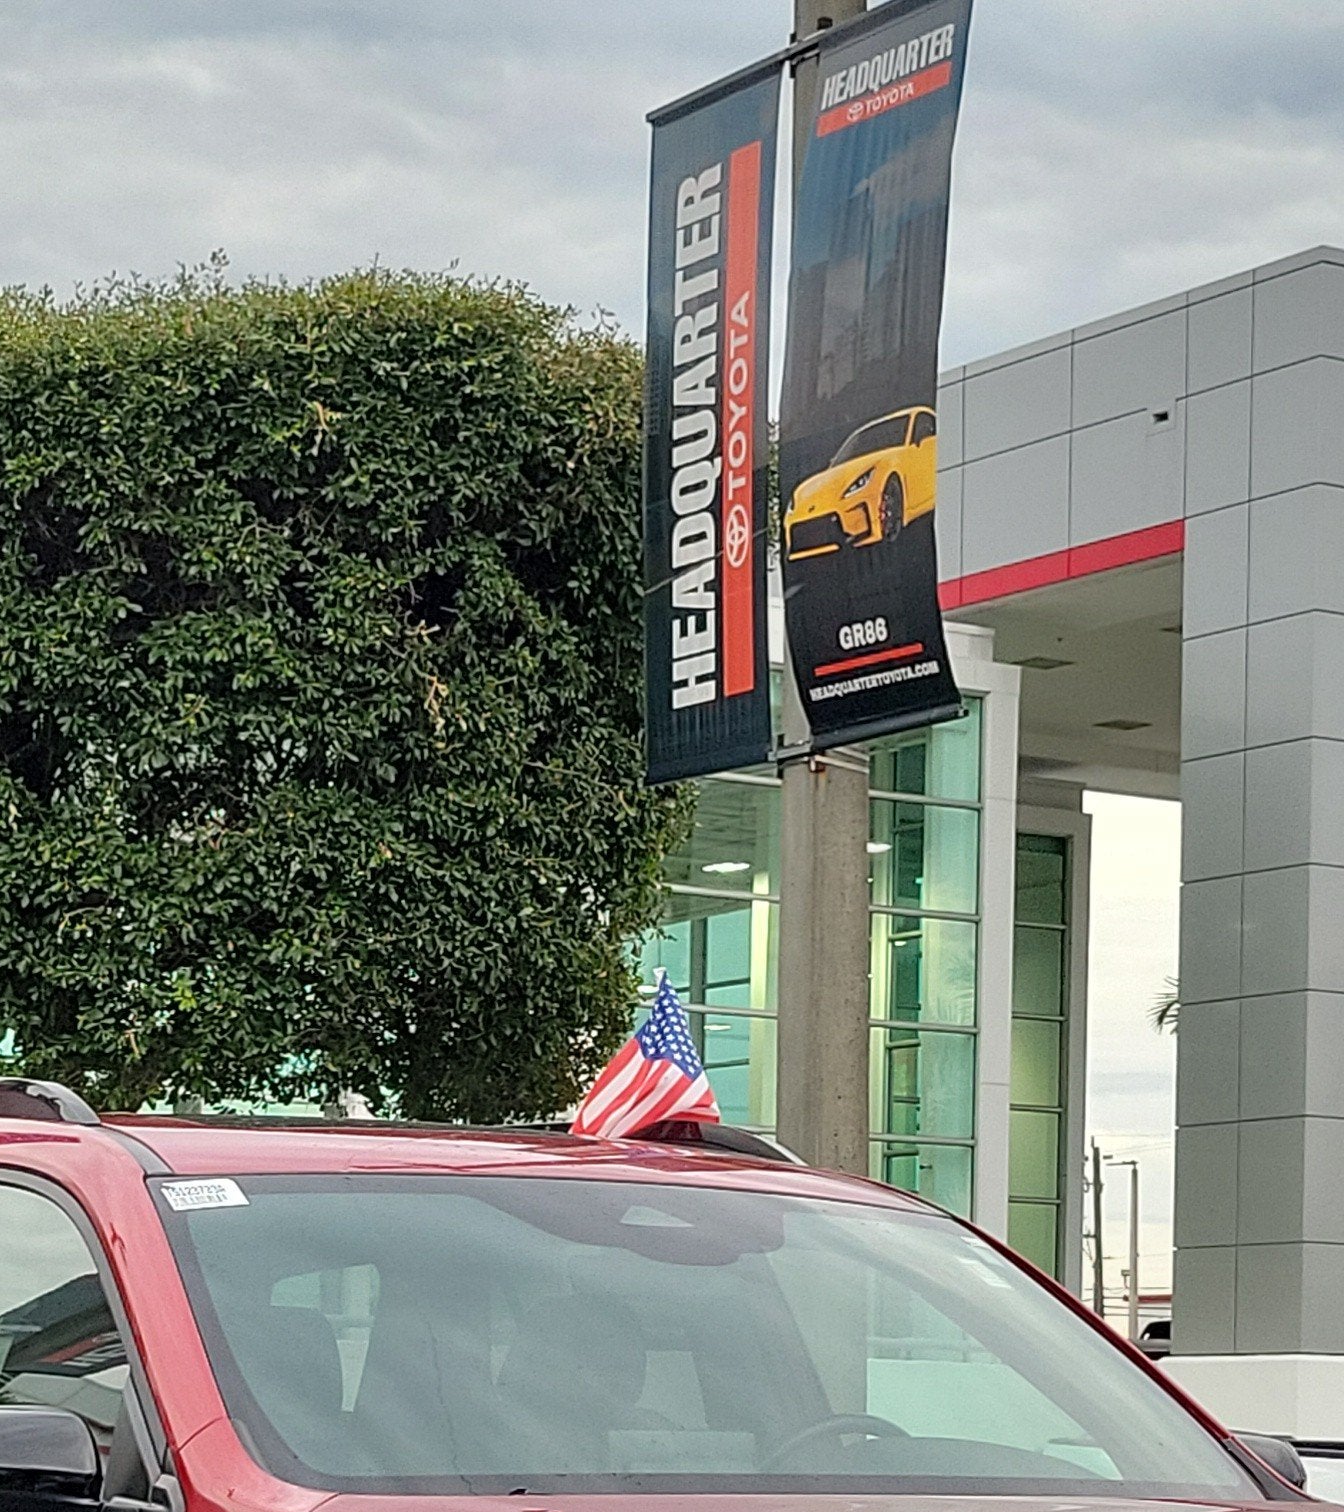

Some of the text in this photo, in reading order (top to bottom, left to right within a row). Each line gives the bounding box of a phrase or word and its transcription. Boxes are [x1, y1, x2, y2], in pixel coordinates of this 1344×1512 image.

[821, 23, 955, 111] HEADQUARTER
[865, 82, 915, 114] TOYOTA
[728, 290, 749, 501] TOYOTA
[670, 162, 723, 710] HEADQUARTER
[838, 617, 888, 650] GR86
[809, 660, 940, 702] HEADQUARTERTOYOTA.COM
